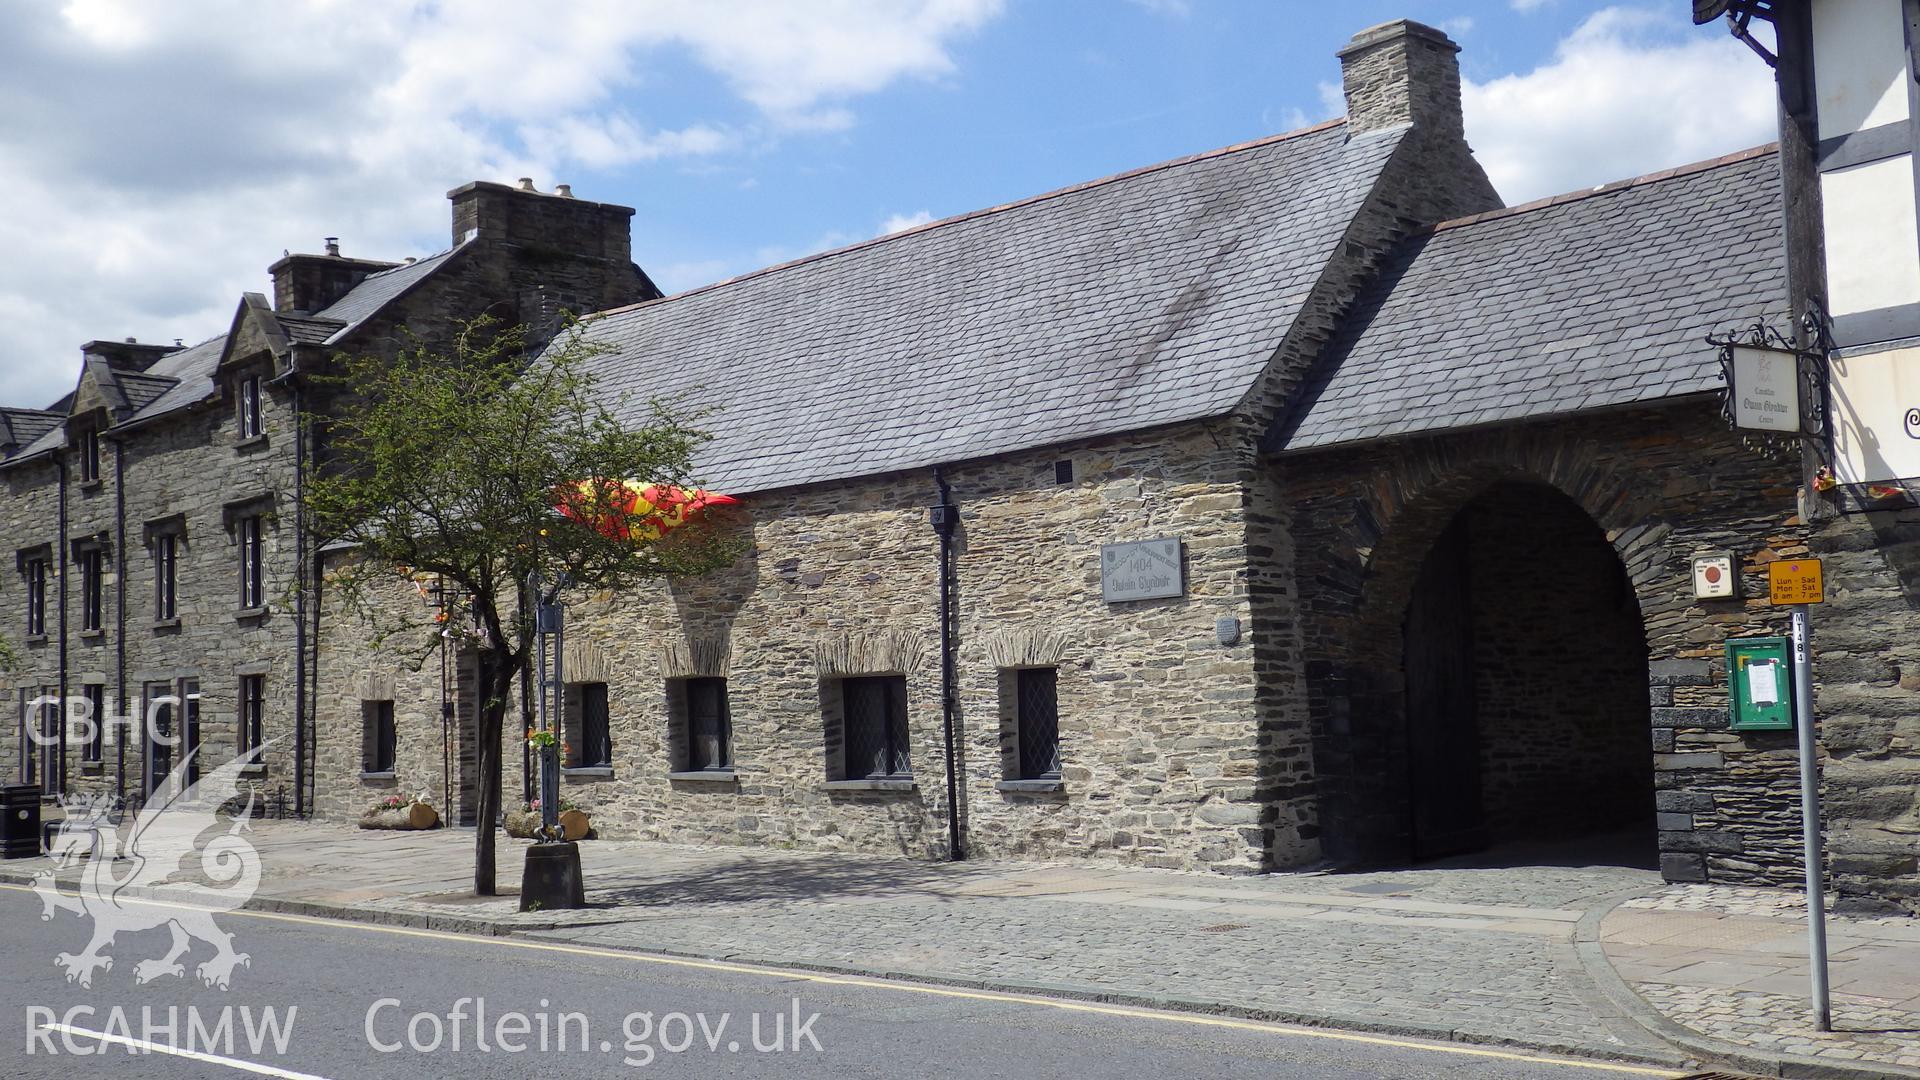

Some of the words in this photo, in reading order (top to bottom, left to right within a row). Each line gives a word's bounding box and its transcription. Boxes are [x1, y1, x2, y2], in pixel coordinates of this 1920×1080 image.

[1129, 557, 1152, 573] 1404
[1801, 576, 1816, 584] Sad
[1773, 592, 1778, 600] 8
